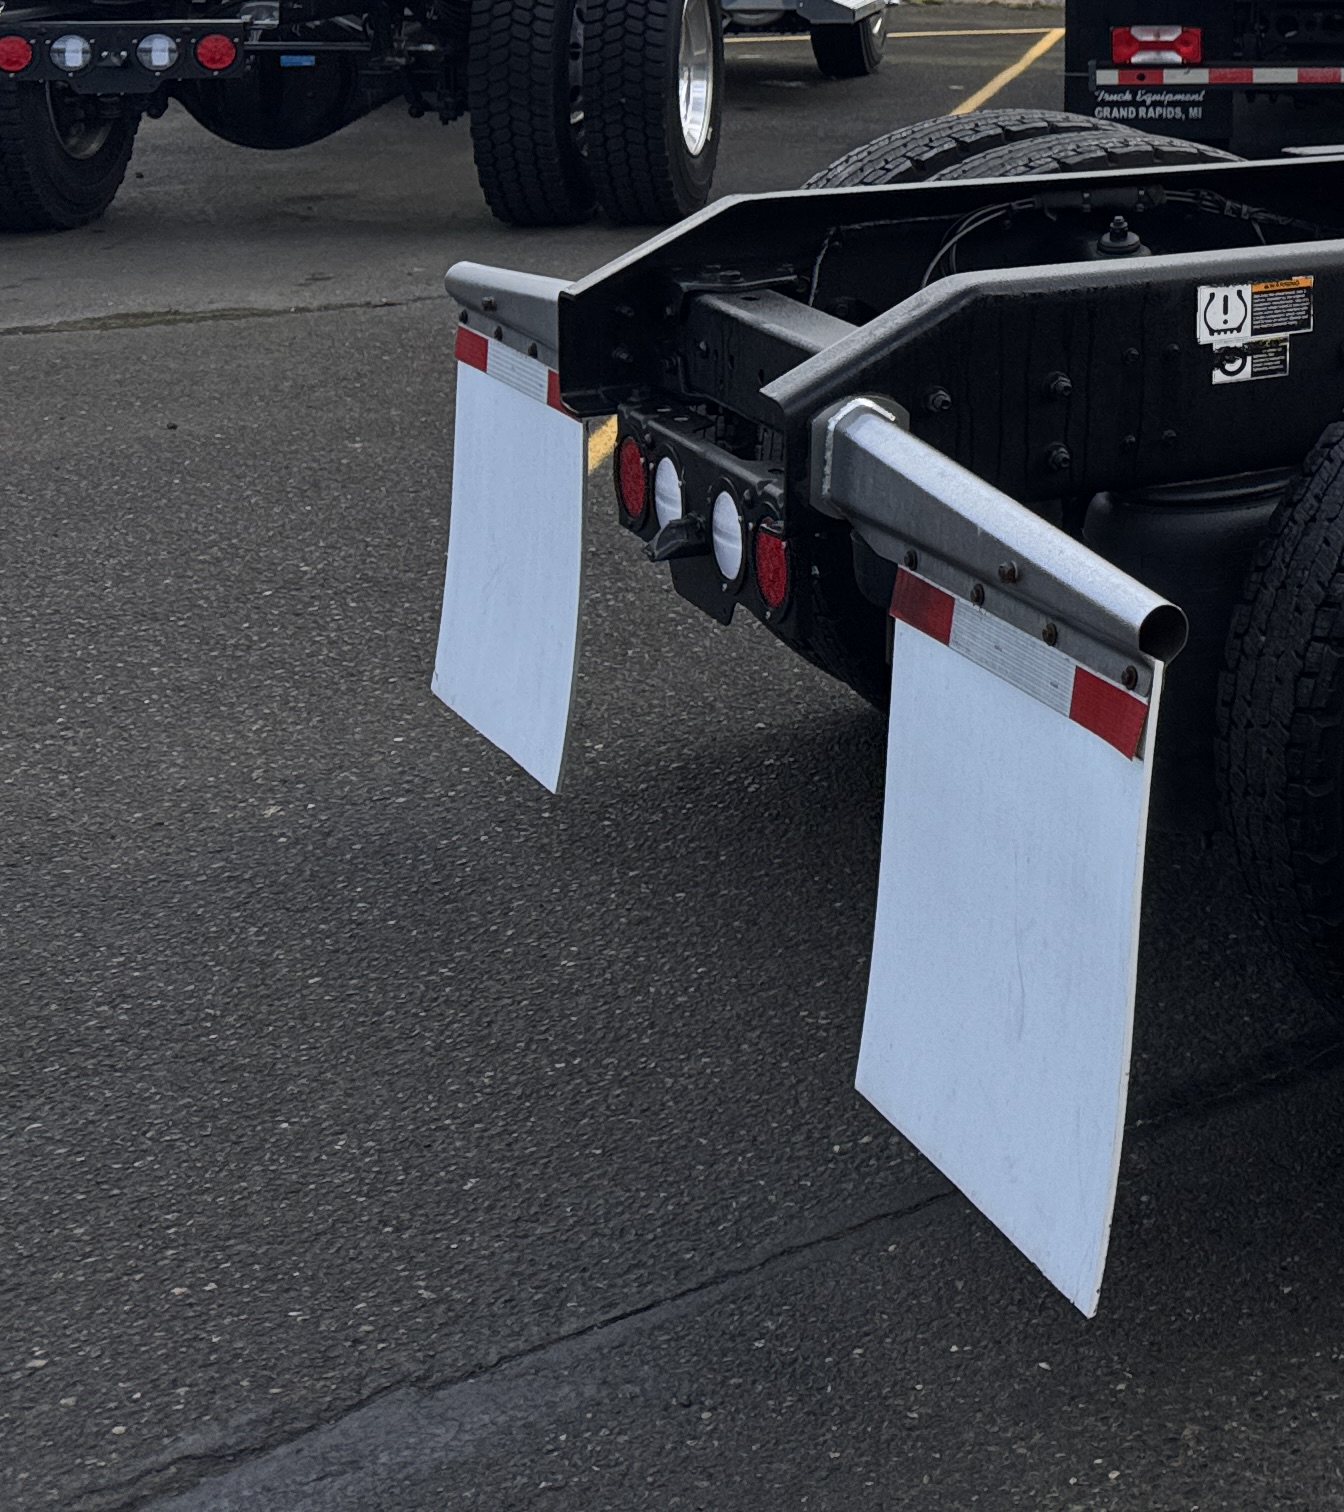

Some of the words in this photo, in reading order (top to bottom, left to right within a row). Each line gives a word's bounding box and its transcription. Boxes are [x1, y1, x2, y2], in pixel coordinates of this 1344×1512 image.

[1095, 90, 1132, 102] Truck
[1136, 90, 1206, 105] Equipment
[1094, 106, 1137, 120] GRAND
[1138, 106, 1186, 121] RAPIDS,
[1188, 106, 1203, 119] MI
